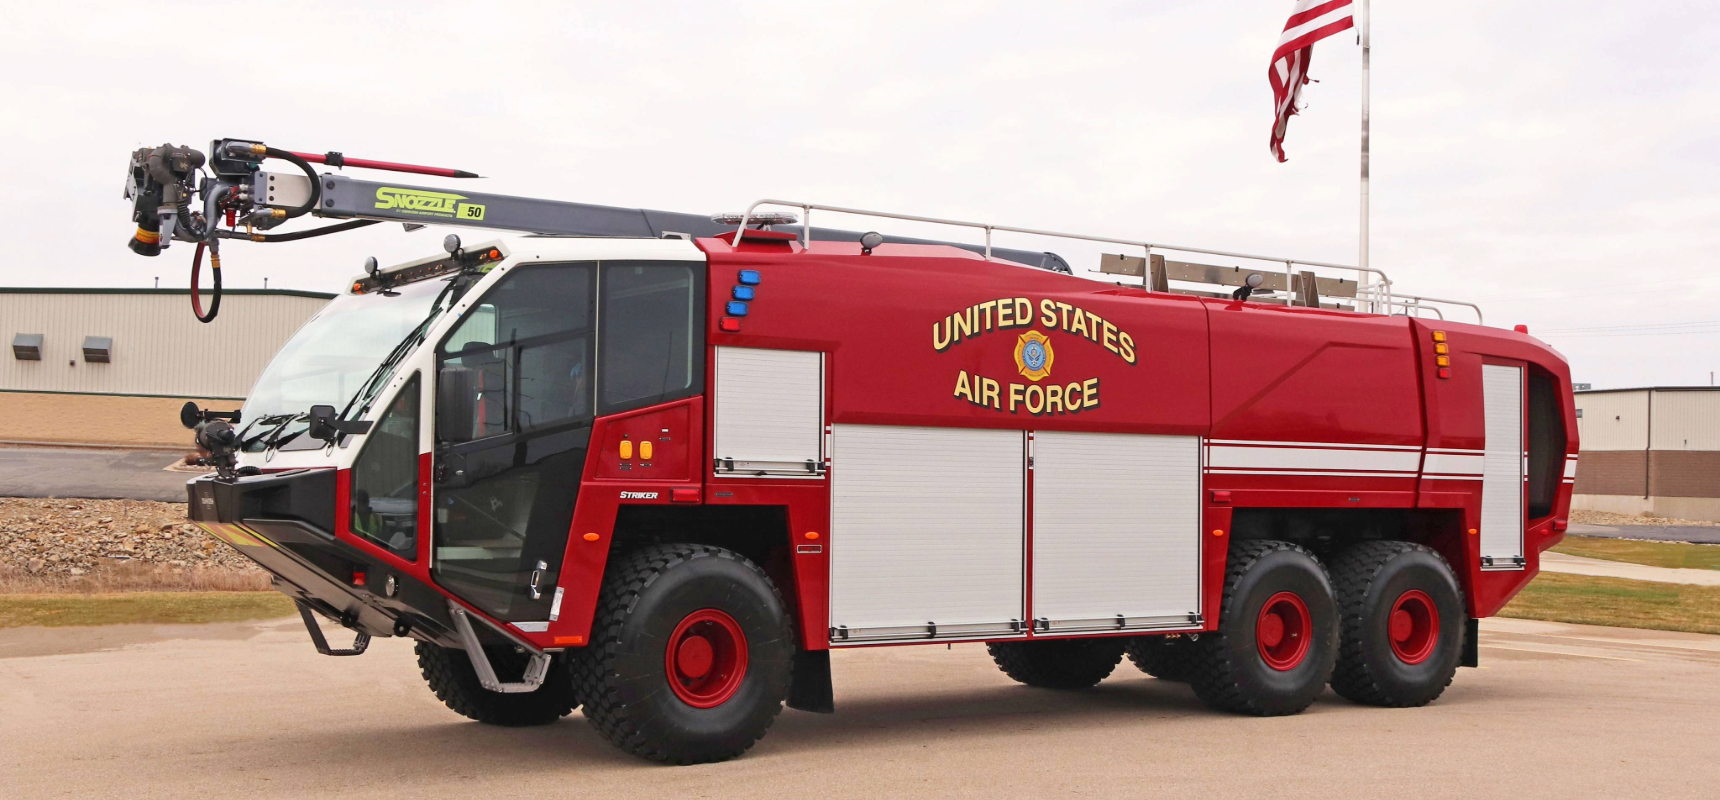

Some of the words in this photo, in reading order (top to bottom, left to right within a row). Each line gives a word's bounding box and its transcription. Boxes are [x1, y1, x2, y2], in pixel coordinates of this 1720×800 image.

[374, 186, 469, 213] SNOZZLE
[467, 206, 482, 218] 50
[933, 297, 1033, 350] UNITED
[1040, 298, 1136, 364] STATES
[954, 369, 1000, 409] AIR
[1009, 377, 1099, 414] FORCE
[619, 491, 659, 499] STRIKER
